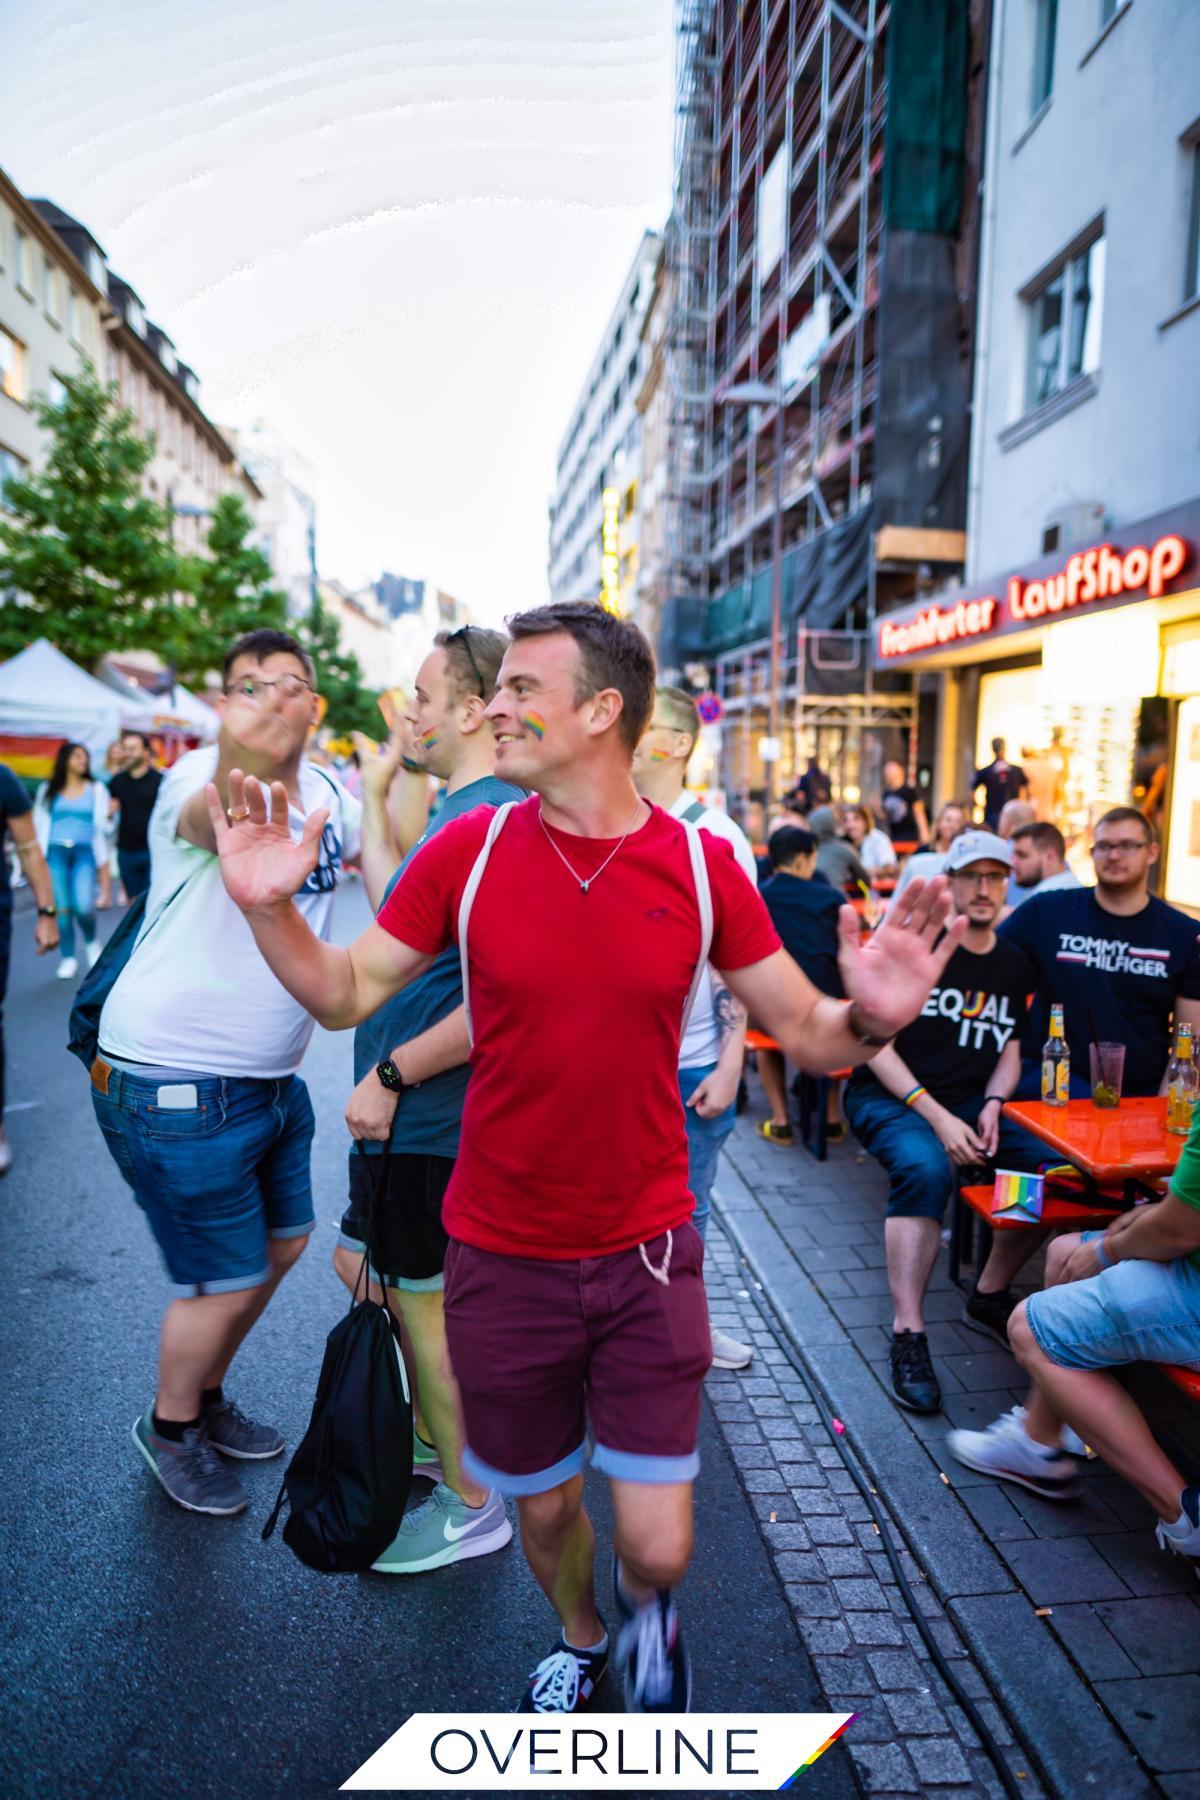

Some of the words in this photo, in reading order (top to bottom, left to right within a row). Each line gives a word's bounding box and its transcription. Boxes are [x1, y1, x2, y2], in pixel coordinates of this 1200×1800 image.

[1059, 933, 1129, 957] TOMMY
[1086, 951, 1169, 978] HILFIGER
[920, 987, 1016, 1026] EQUAL
[958, 1019, 1013, 1053] ITY
